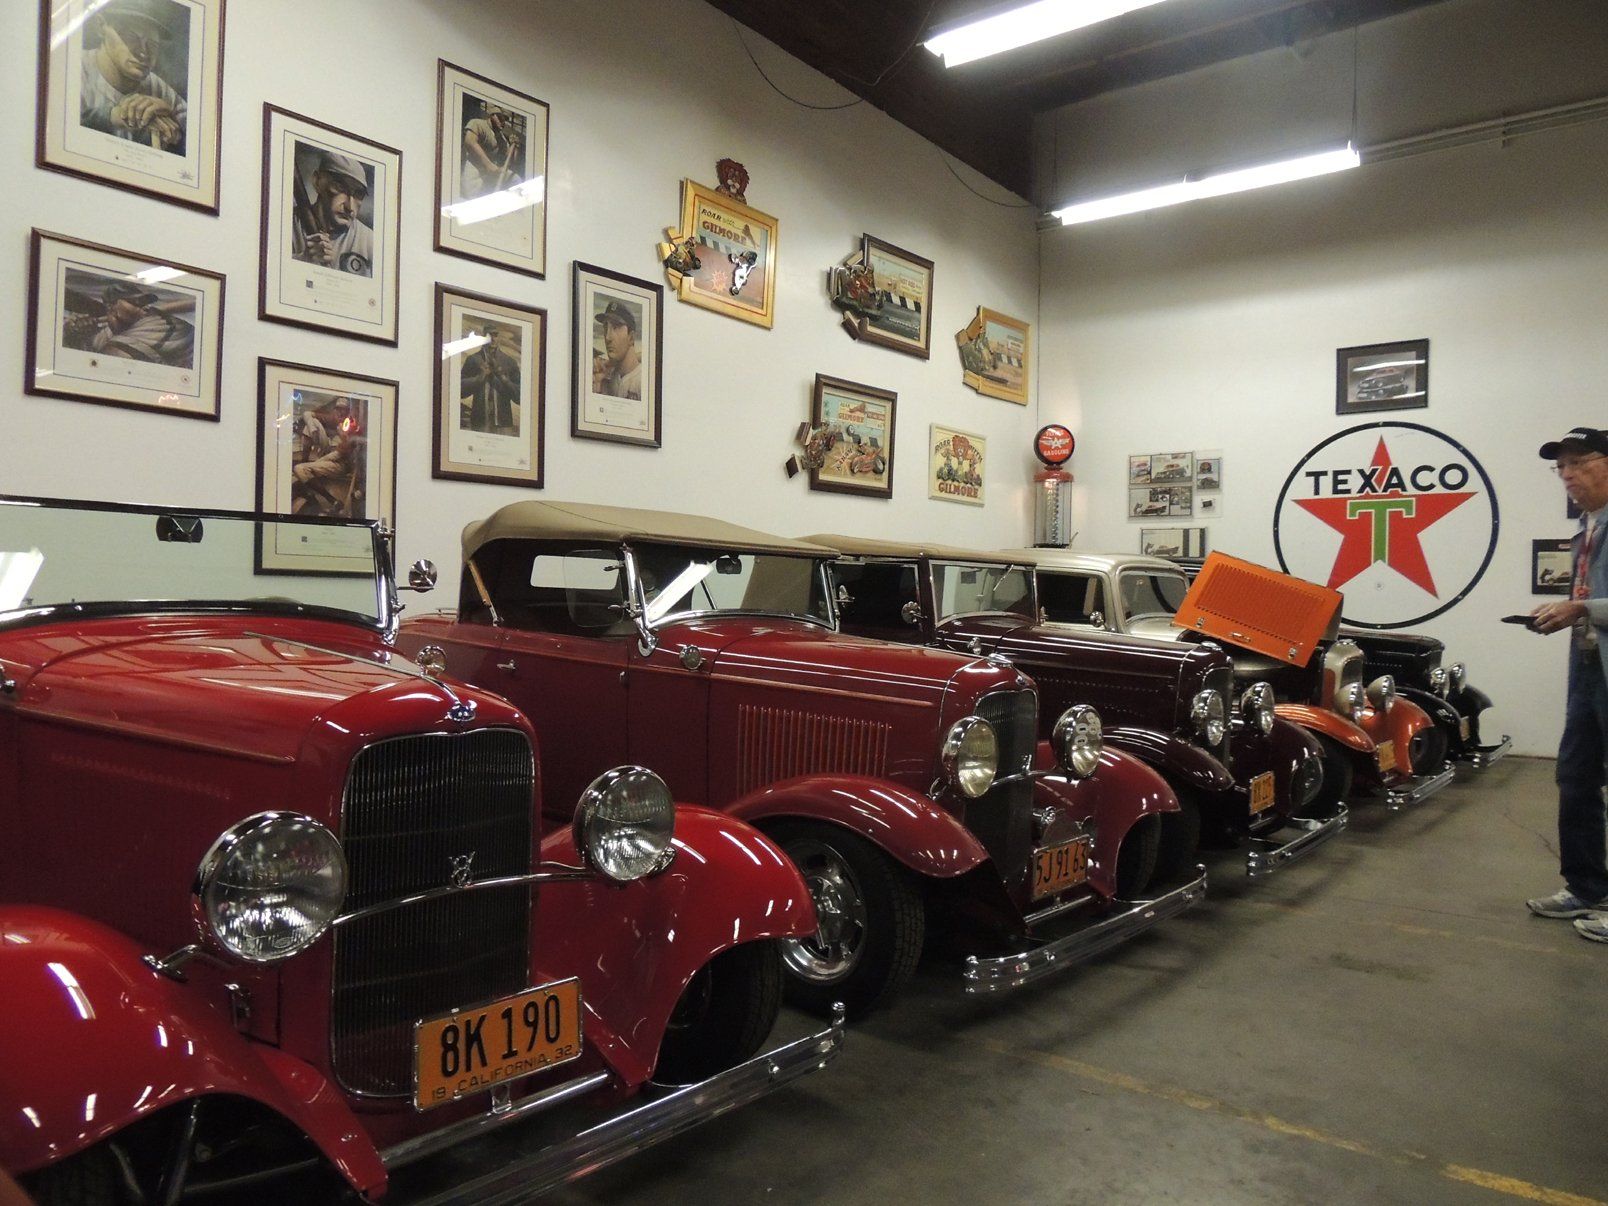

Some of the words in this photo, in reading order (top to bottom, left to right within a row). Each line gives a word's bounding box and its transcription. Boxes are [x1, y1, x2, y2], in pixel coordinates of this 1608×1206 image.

[702, 208, 722, 221] ROAR
[702, 220, 747, 245] GILMORE
[938, 481, 979, 499] GILMORE
[1305, 463, 1469, 496] TEXACO
[1346, 497, 1416, 566] T
[441, 1014, 488, 1078] 8K
[501, 994, 561, 1060] 190
[432, 1087, 447, 1100] 19
[457, 1053, 548, 1092] CALIFORNIA
[555, 1044, 573, 1060] 32
